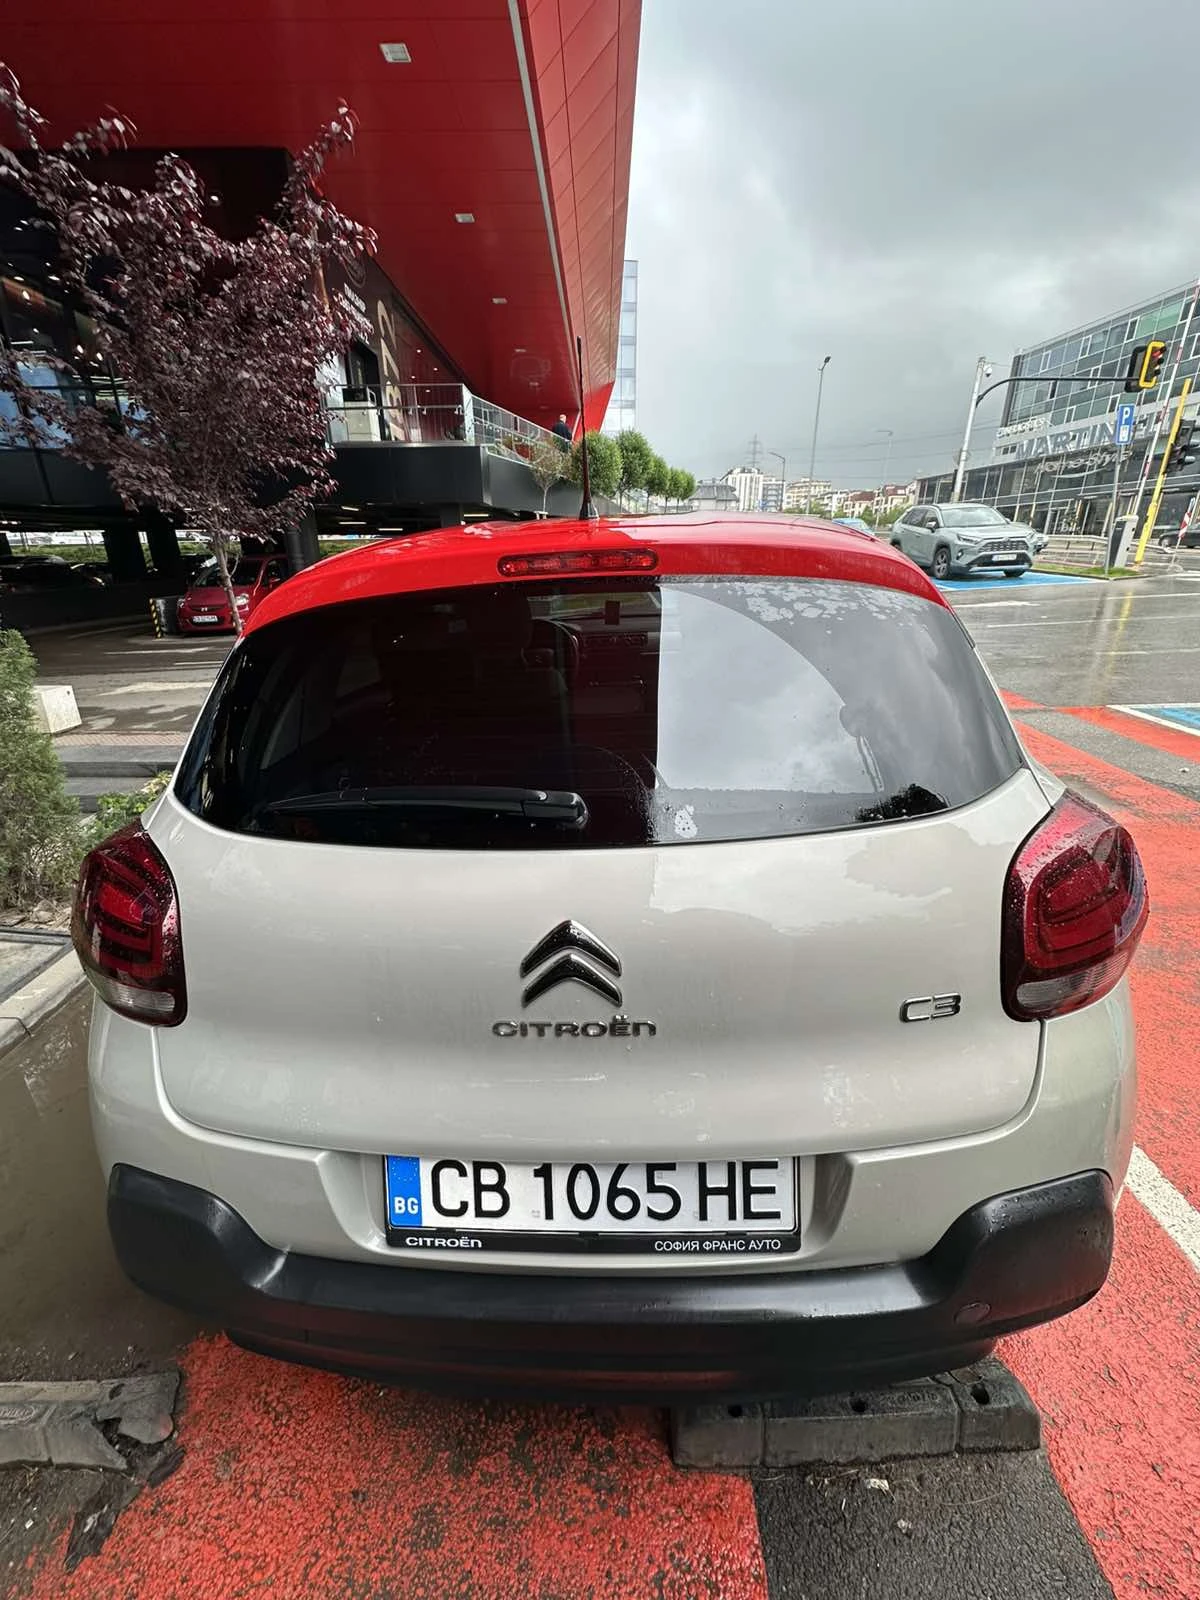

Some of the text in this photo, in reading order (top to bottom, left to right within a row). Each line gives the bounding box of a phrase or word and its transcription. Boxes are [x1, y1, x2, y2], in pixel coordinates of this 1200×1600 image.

[1122, 406, 1131, 425] P
[899, 992, 961, 1023] C3
[431, 1159, 781, 1221] CB 1065 HE
[393, 1196, 420, 1215] BG
[654, 1239, 781, 1252] СОФИЯ ФРАНС АУТО
